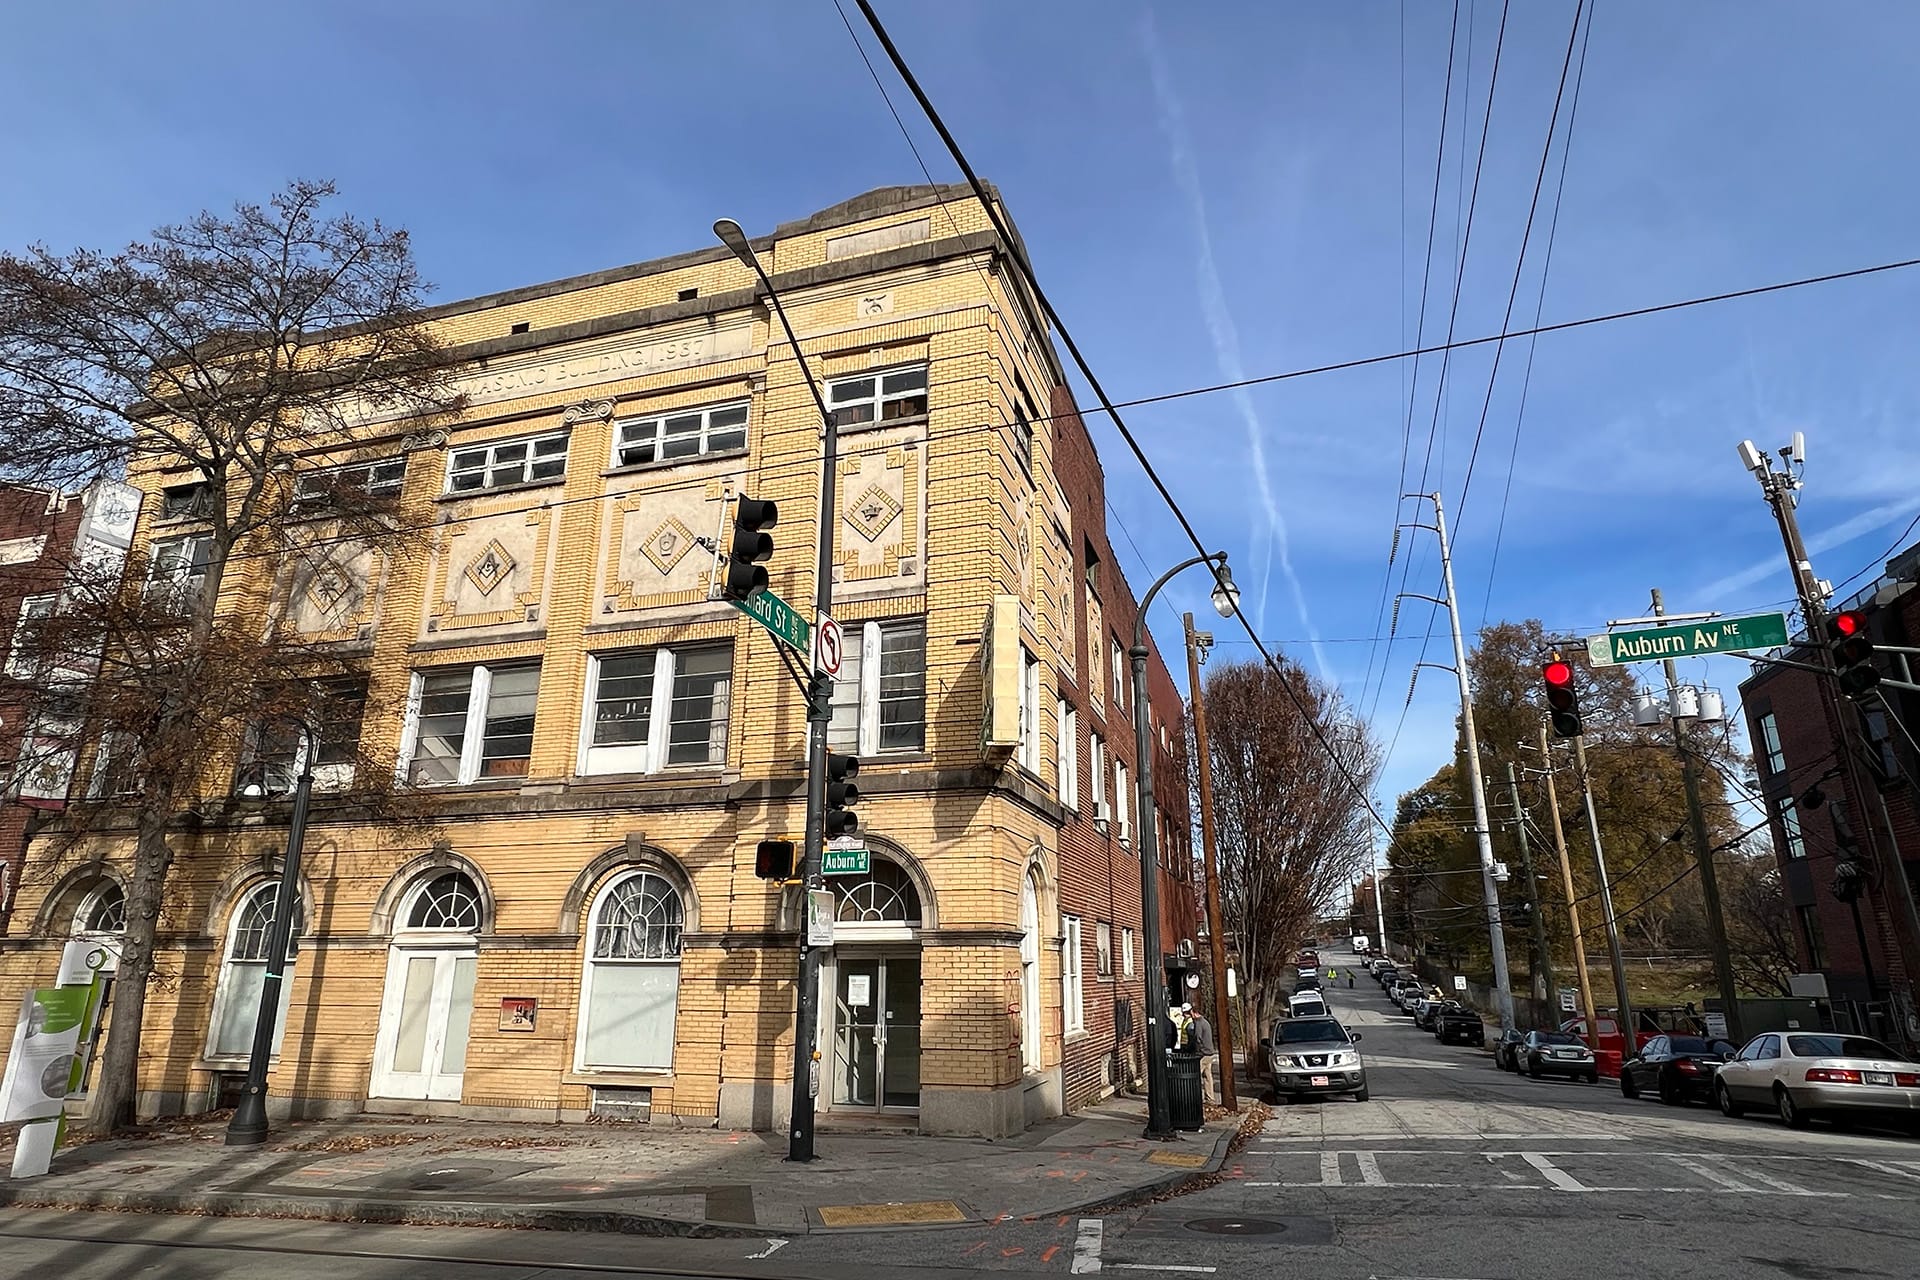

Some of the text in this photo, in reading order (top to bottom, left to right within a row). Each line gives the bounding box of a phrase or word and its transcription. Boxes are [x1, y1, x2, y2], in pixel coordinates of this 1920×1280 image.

[775, 605, 787, 633] St
[1616, 635, 1686, 658] Auburn
[1694, 629, 1718, 650] Av
[1722, 623, 1740, 636] NE
[825, 853, 856, 869] Auburn
